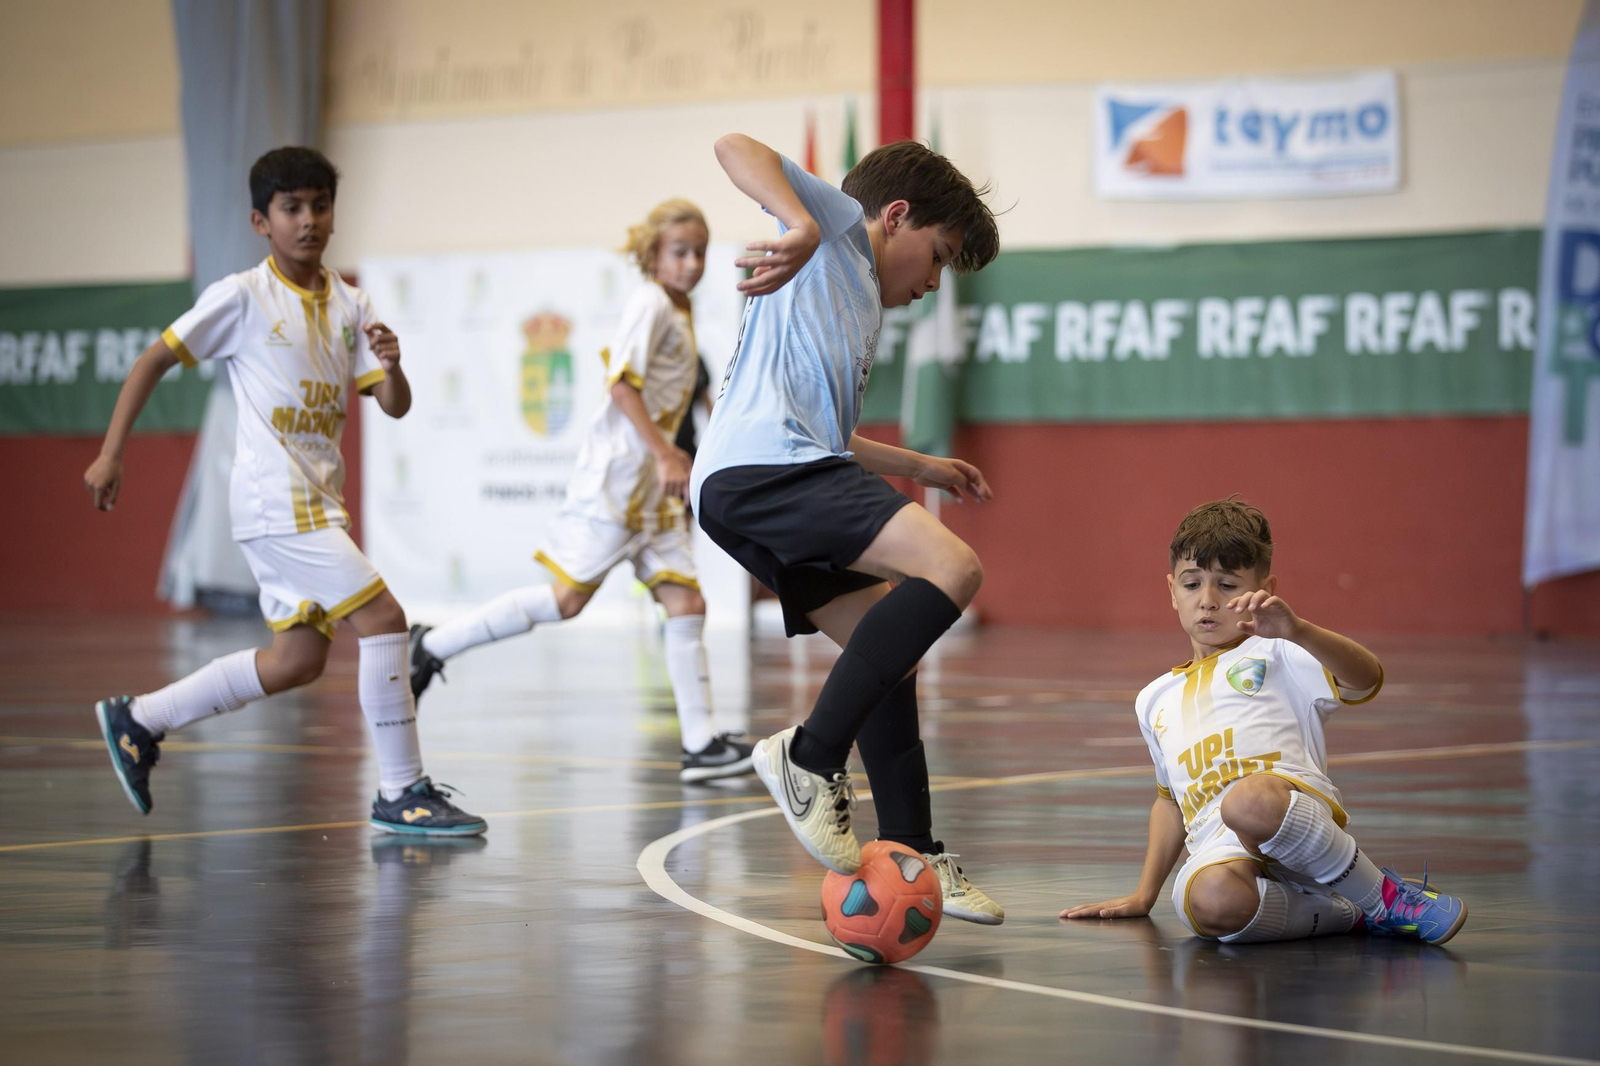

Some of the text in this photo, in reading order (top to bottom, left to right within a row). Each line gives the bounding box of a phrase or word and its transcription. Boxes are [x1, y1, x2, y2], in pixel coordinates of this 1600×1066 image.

[1054, 300, 1194, 362] RFAF
[1196, 294, 1340, 359] RFAF
[1344, 289, 1485, 355] RFAF
[1178, 727, 1235, 780] UP!
